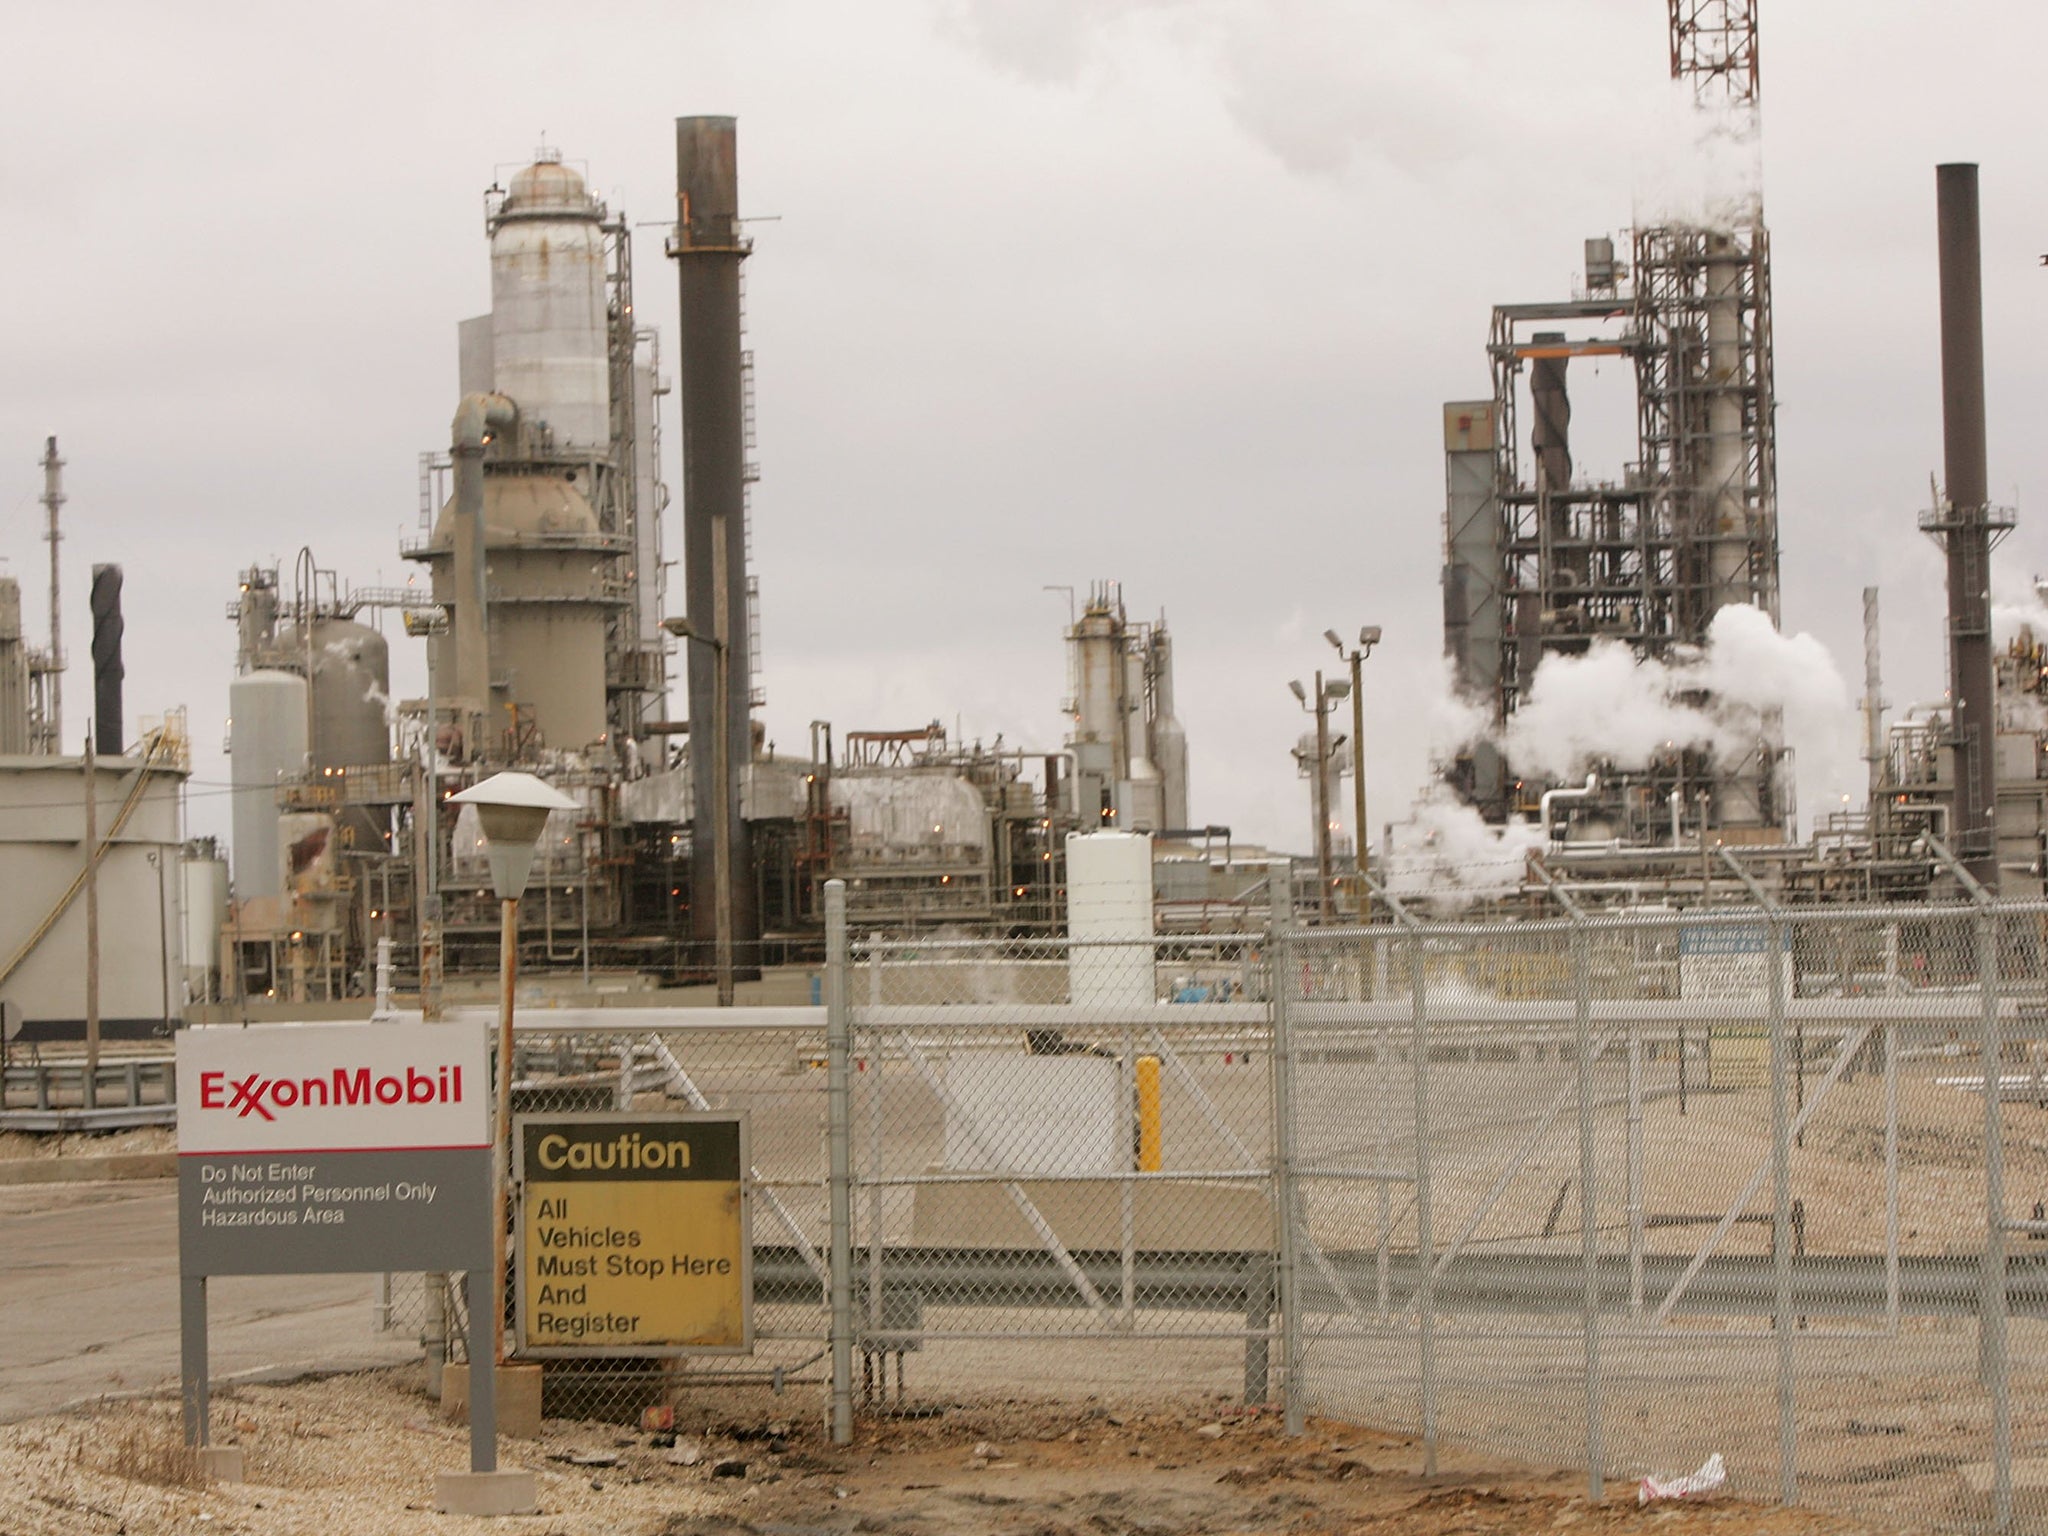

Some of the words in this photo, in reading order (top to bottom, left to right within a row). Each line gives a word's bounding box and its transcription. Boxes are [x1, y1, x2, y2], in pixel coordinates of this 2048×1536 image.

[200, 1064, 463, 1121] ExxonMobil
[537, 1132, 691, 1170] Caution
[201, 1164, 227, 1184] Do
[231, 1163, 263, 1182] Not
[268, 1163, 317, 1182] Enter
[201, 1185, 298, 1205] Authorized
[302, 1183, 391, 1202] Personnel
[395, 1181, 438, 1205] Only
[201, 1207, 298, 1227] Hazardous
[302, 1206, 345, 1225] Area
[536, 1198, 568, 1220] All
[537, 1226, 642, 1248] Vehicles
[536, 1255, 598, 1276] Must
[606, 1254, 665, 1280] Stop
[671, 1254, 731, 1276] Here
[537, 1283, 587, 1305] And
[537, 1312, 640, 1338] Register
